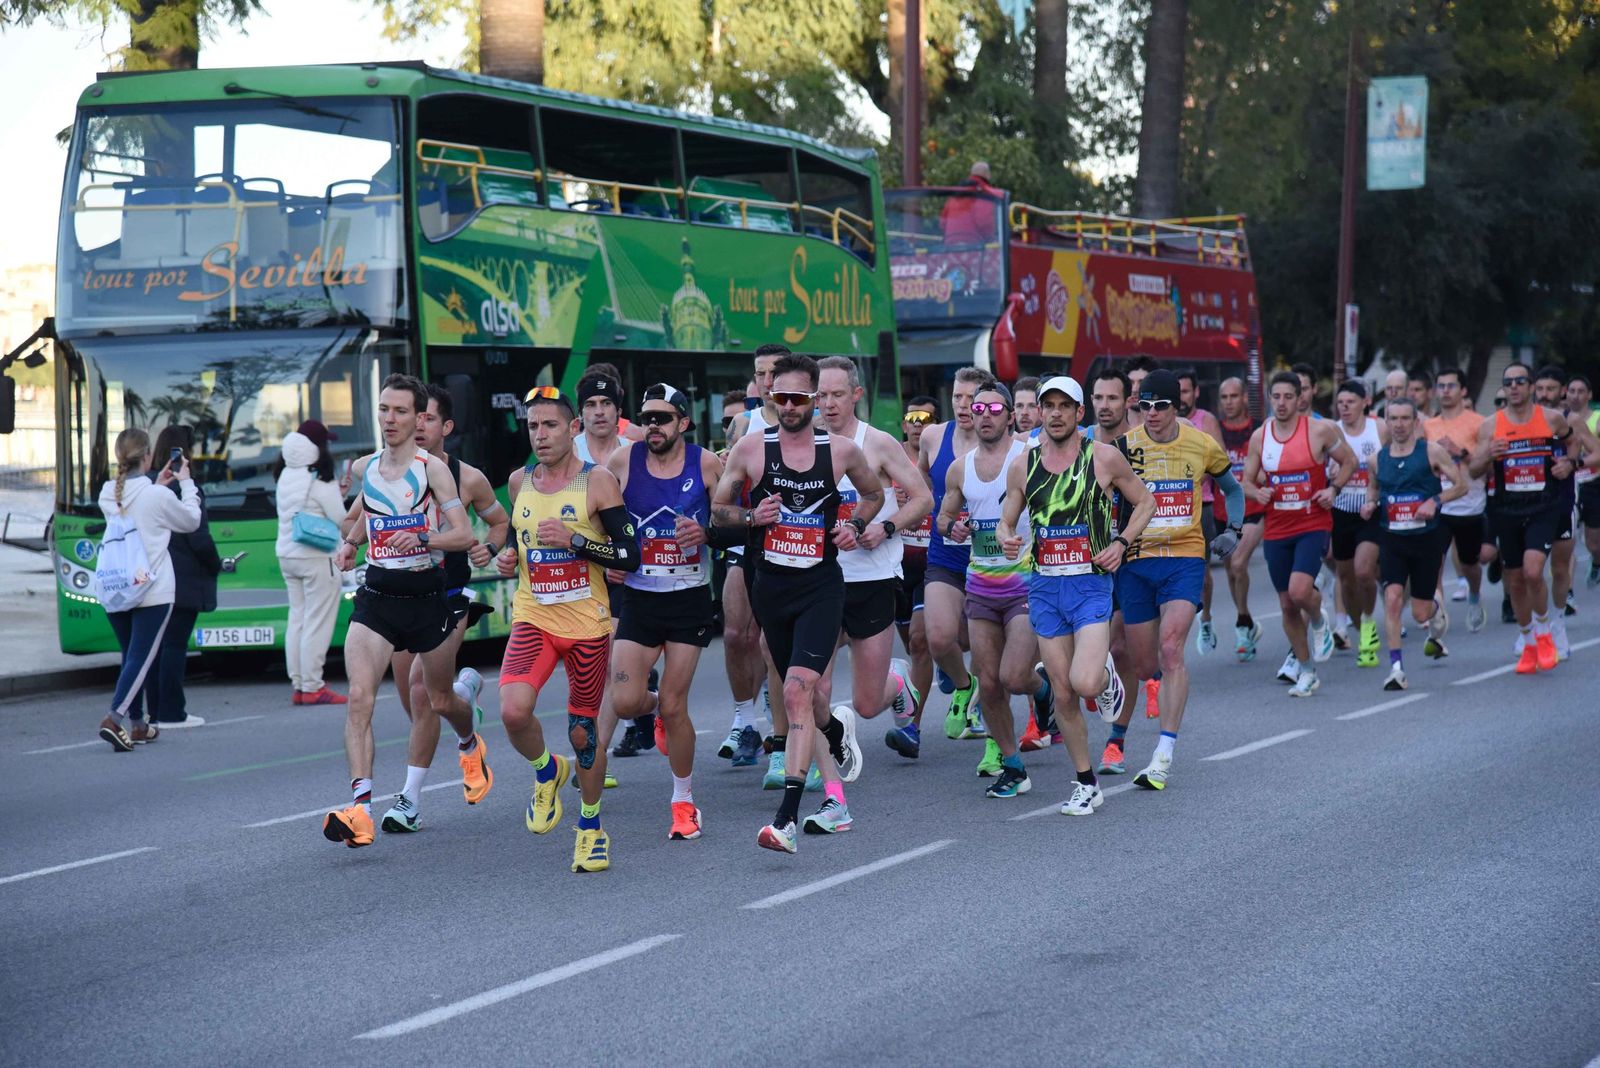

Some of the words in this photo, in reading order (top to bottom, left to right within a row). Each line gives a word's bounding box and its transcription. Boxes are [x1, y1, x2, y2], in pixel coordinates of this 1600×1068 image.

[83, 269, 136, 289] tour
[143, 269, 188, 295] por
[177, 241, 368, 302] Sevilla
[730, 277, 759, 313] tour
[764, 290, 786, 328] por
[783, 245, 872, 344] Sevilla
[481, 294, 520, 332] alsa
[1281, 474, 1305, 482] ZURICH
[1159, 482, 1188, 490] ZURICH
[386, 517, 417, 527] ZURICH
[786, 515, 819, 525] ZURICH
[1050, 528, 1081, 536] ZURICH
[771, 539, 817, 555] THOMAS
[655, 552, 687, 564] FUSTA
[1043, 550, 1084, 564] GUILLÉN
[549, 568, 564, 577] 743
[531, 581, 569, 592] ANTONIO
[571, 577, 590, 588] C.B.
[204, 629, 240, 643] 7156
